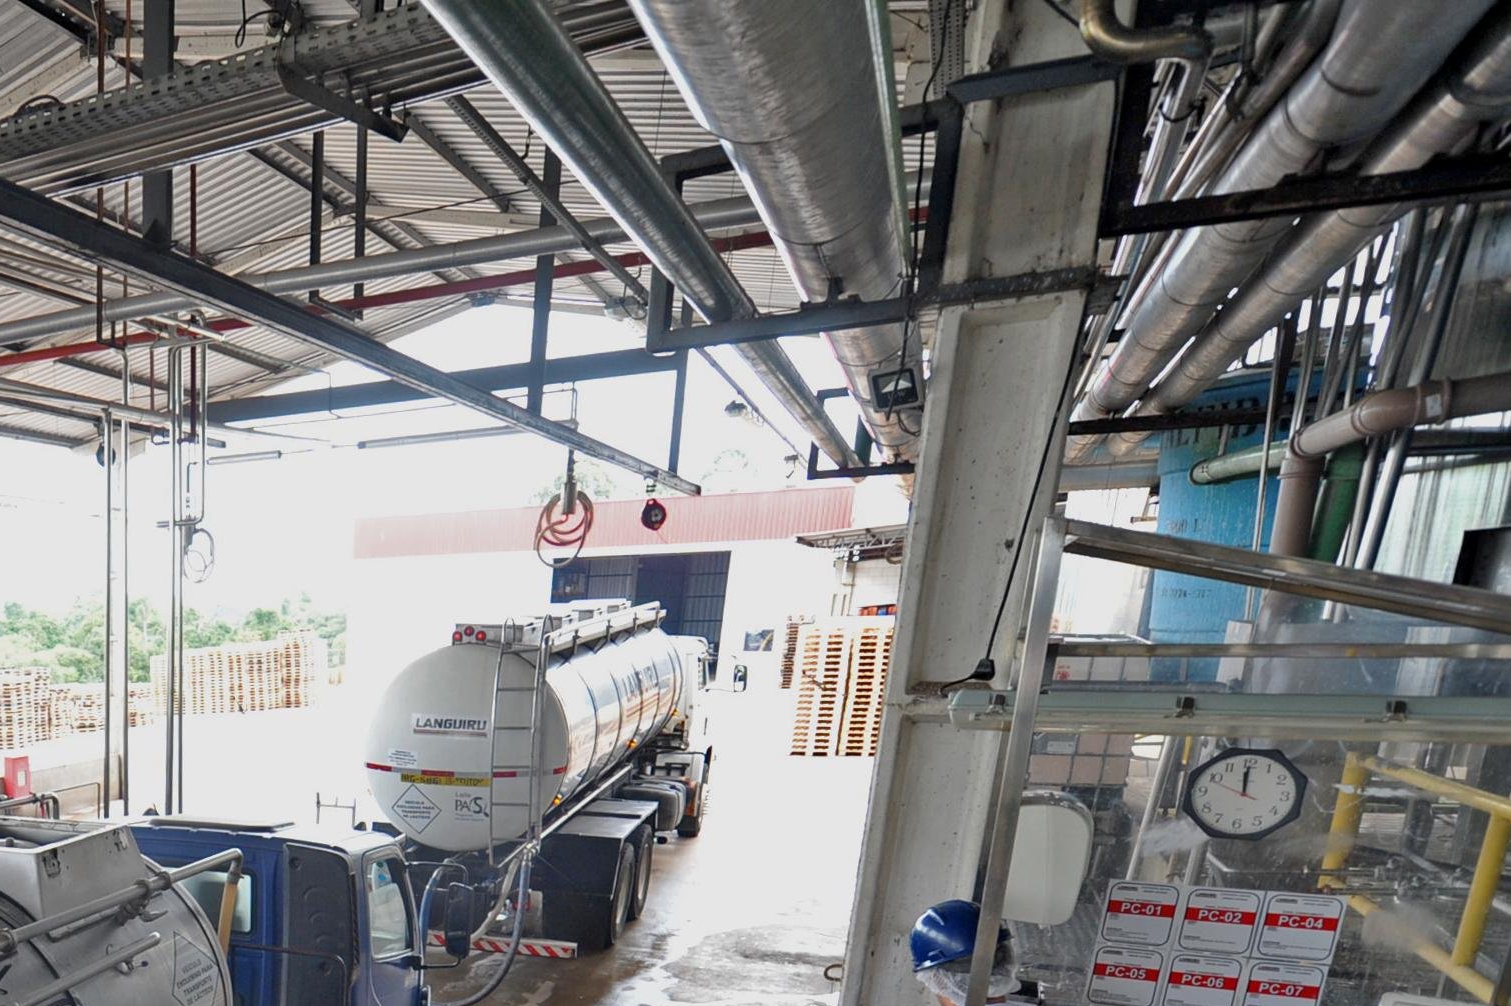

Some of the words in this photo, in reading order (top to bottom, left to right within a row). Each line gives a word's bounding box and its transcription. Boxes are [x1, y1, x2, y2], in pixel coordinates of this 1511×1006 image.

[416, 718, 487, 731] LANGUIRU
[1225, 762, 1235, 773] 11
[1243, 758, 1258, 769] 12
[1267, 763, 1272, 774] 1
[1209, 773, 1223, 784] 10
[1276, 774, 1287, 786] 2
[1198, 786, 1208, 797] 9
[1280, 791, 1290, 802] 3
[455, 797, 486, 814] PAS
[1201, 802, 1212, 813] 8
[1269, 805, 1278, 817] 4
[1214, 813, 1224, 824] 7
[1232, 818, 1242, 829] 6
[1252, 816, 1263, 826] 5
[1121, 903, 1162, 916] PC-01
[1198, 909, 1242, 924] PC-02
[1278, 915, 1324, 930] PC-04
[1105, 965, 1147, 980] PC-05
[1181, 973, 1225, 988] PC-06
[1258, 982, 1305, 997] PC-07
